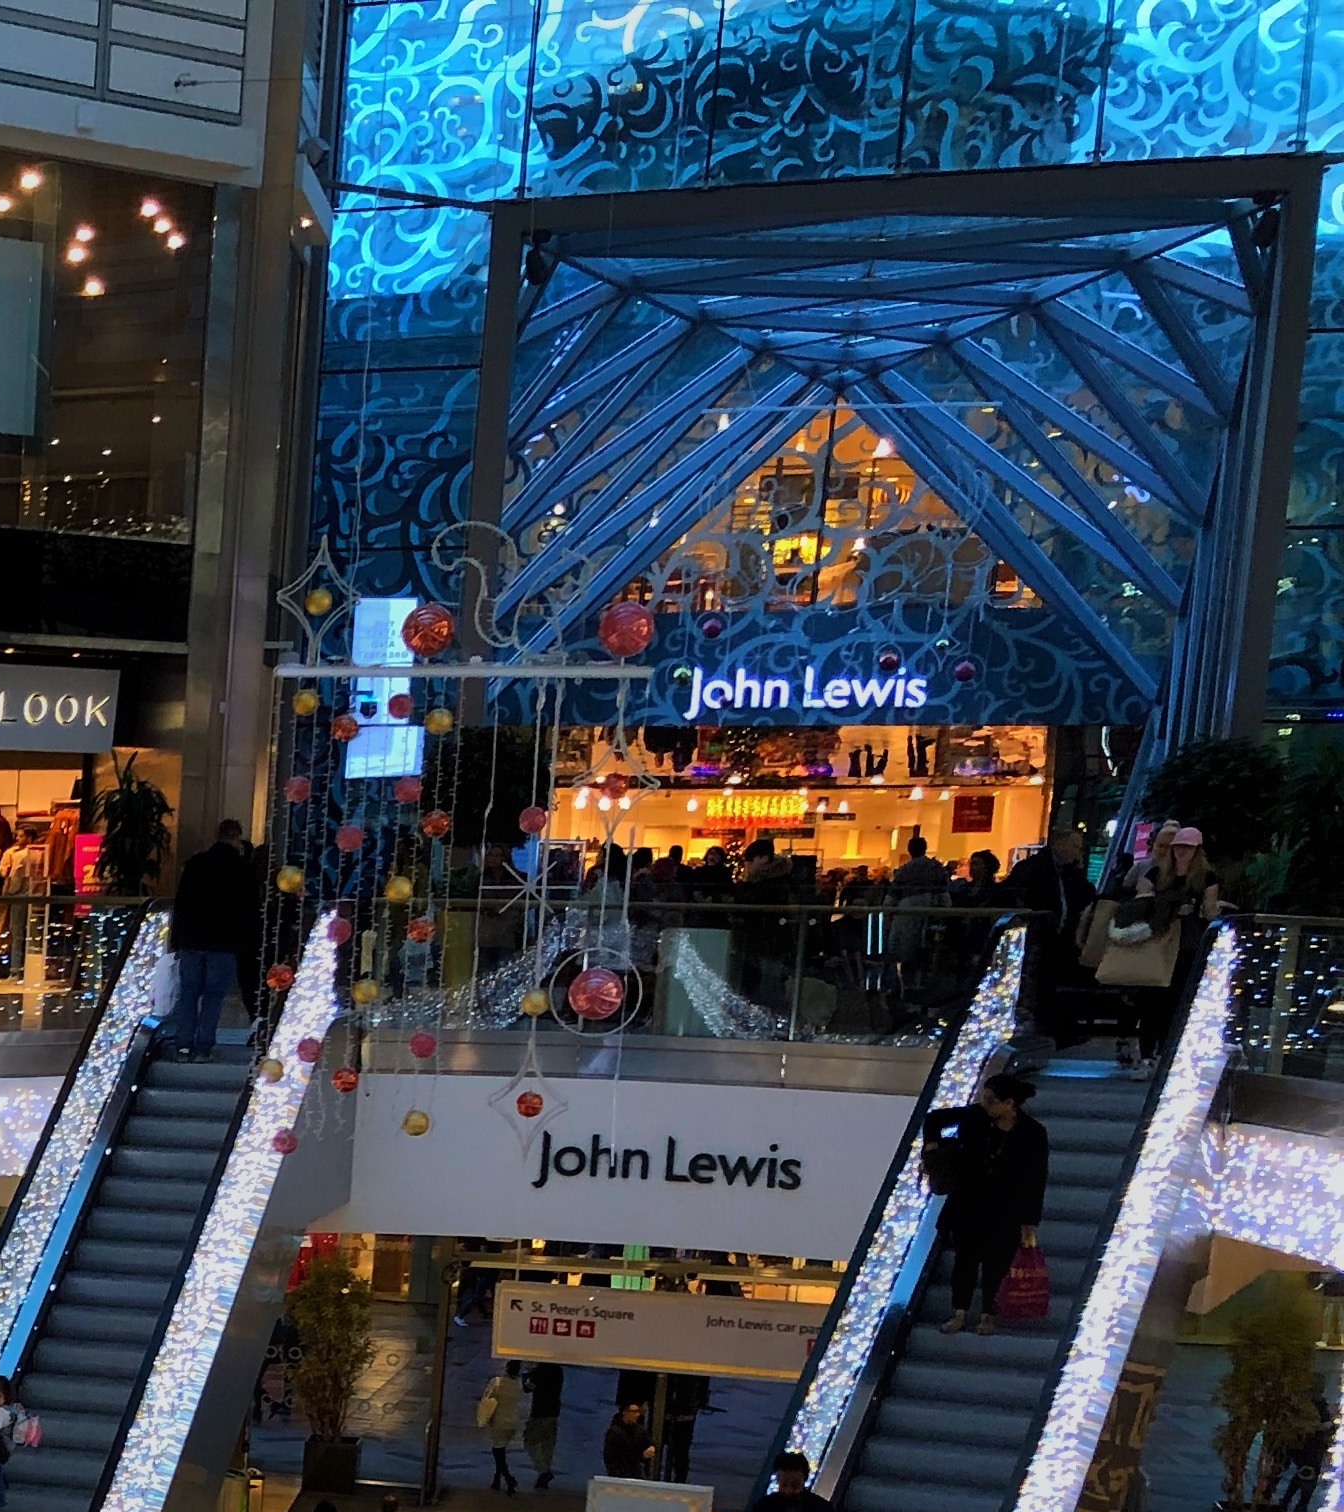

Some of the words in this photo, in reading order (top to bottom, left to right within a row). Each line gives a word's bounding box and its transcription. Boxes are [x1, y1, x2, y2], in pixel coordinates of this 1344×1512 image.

[682, 664, 790, 722] John
[803, 664, 928, 709] Lewis
[531, 1130, 650, 1189] John
[665, 1135, 802, 1190] Lewis
[530, 1301, 546, 1314] St.
[549, 1303, 590, 1318] Peter's
[592, 1306, 635, 1322] Square
[706, 1315, 734, 1329] John
[738, 1317, 773, 1333] Lewis
[776, 1322, 796, 1333] car
